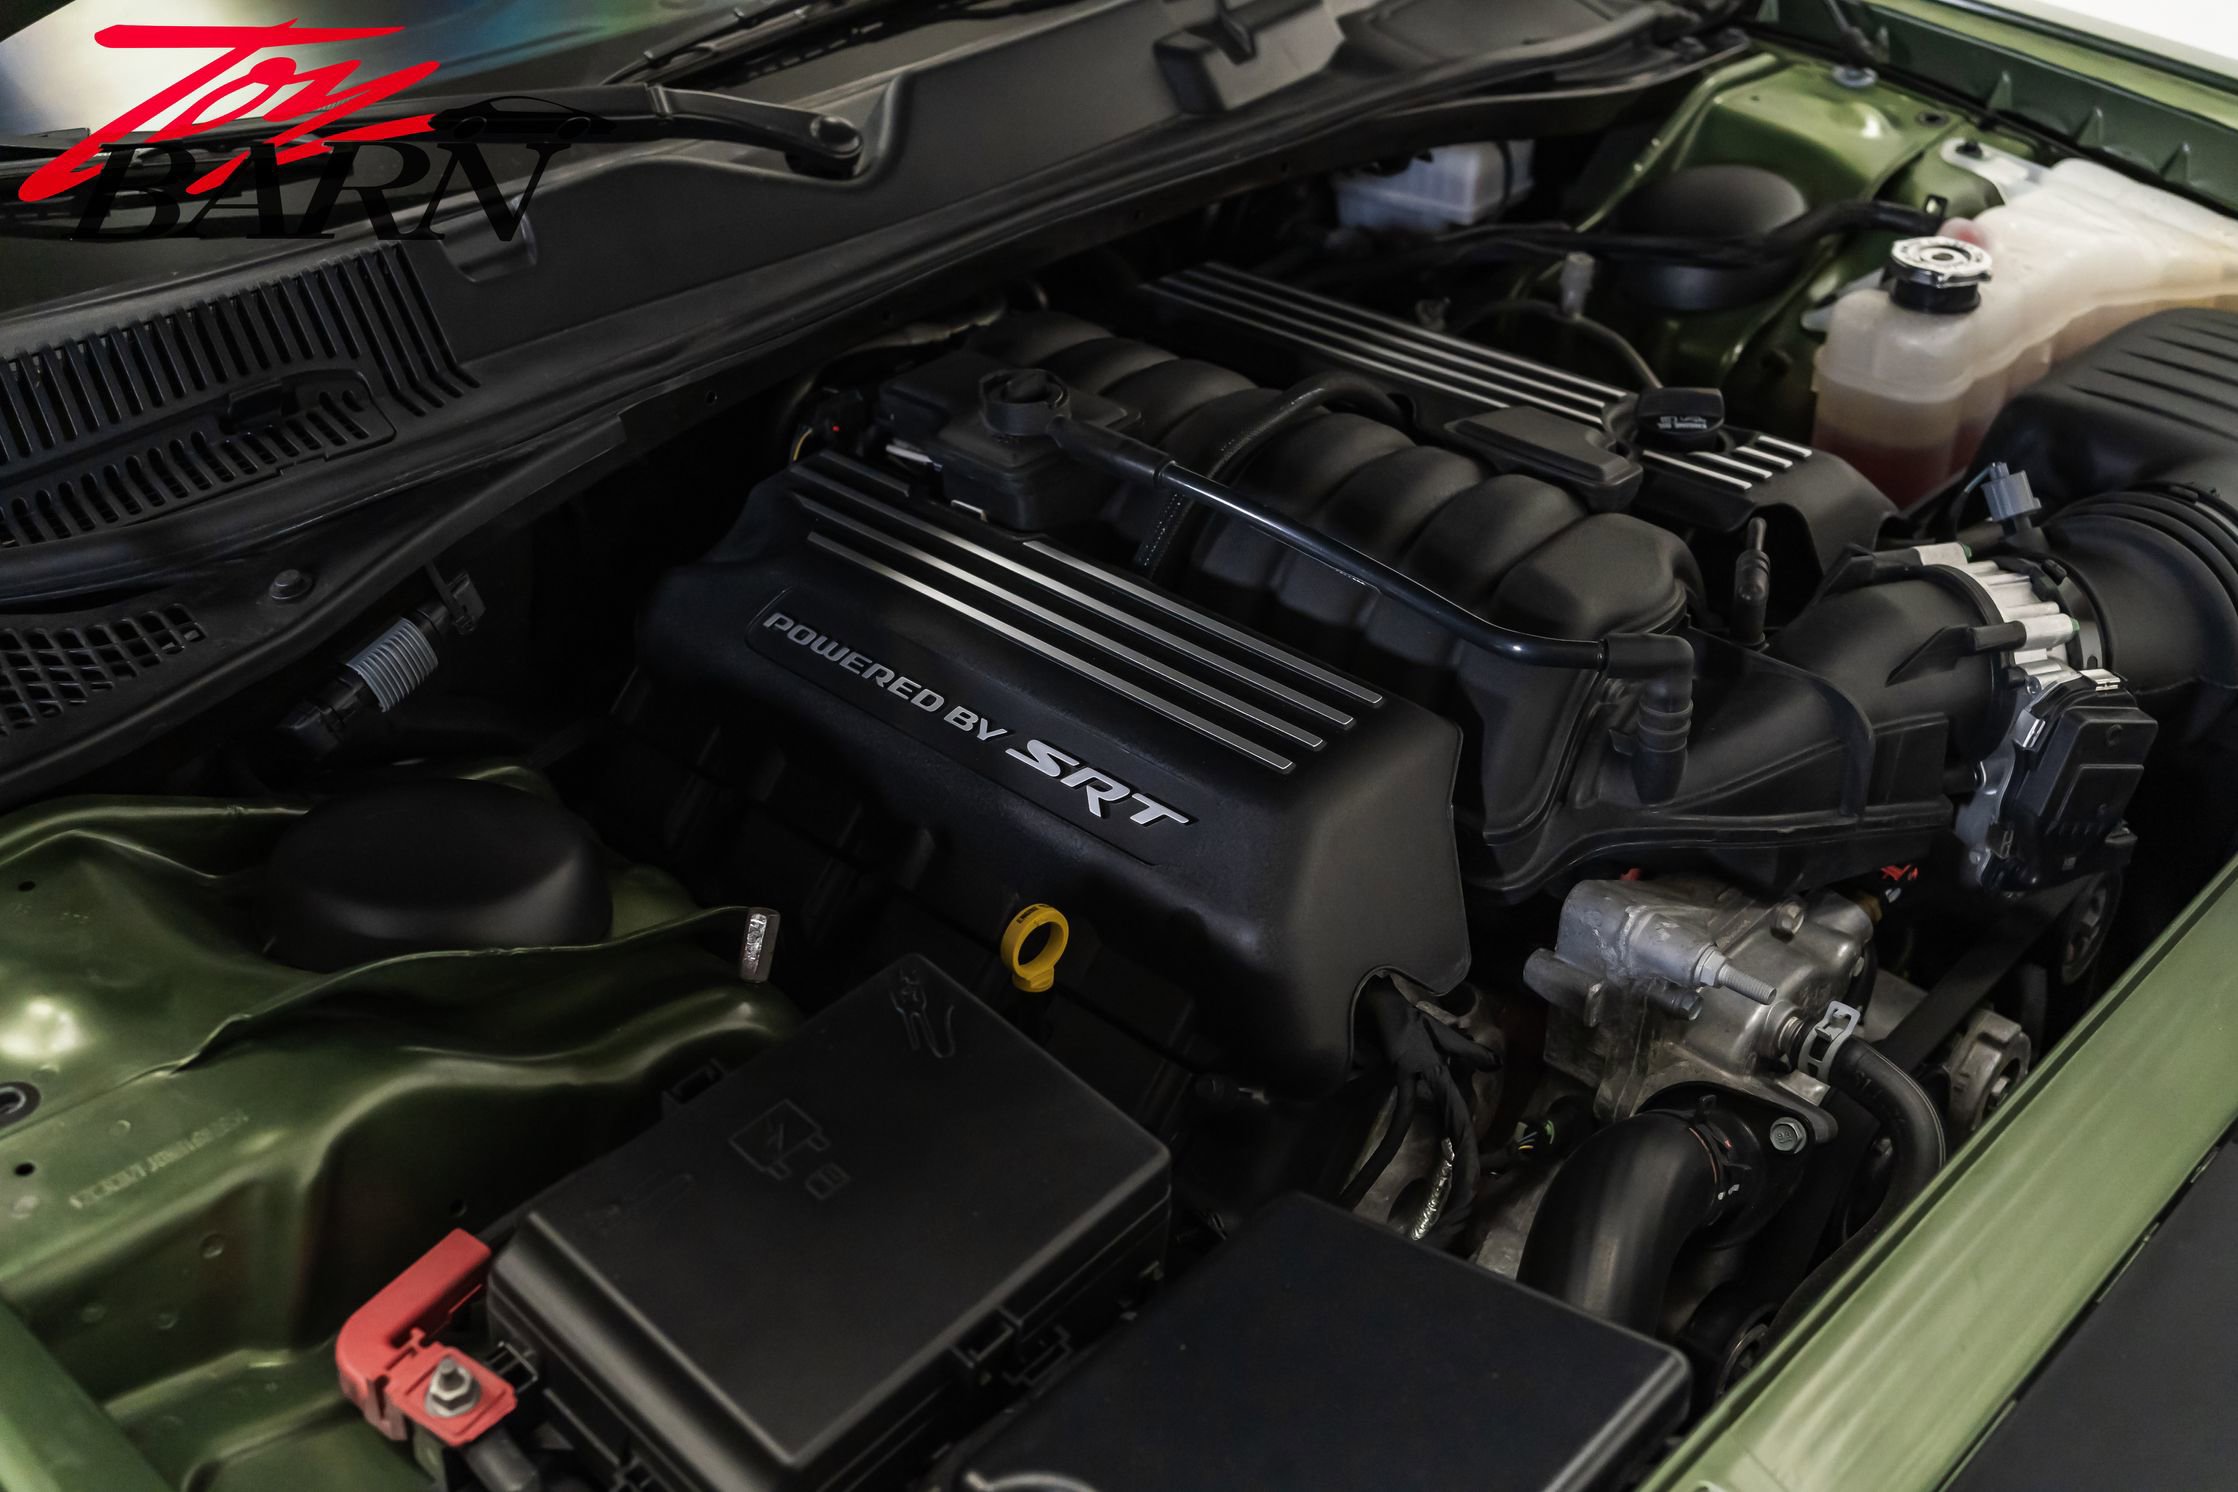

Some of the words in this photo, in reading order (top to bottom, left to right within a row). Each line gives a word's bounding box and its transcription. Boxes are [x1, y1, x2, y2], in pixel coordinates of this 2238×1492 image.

[763, 611, 945, 713] POWERED
[943, 705, 1008, 742] BY
[1005, 739, 1190, 825] SRT
